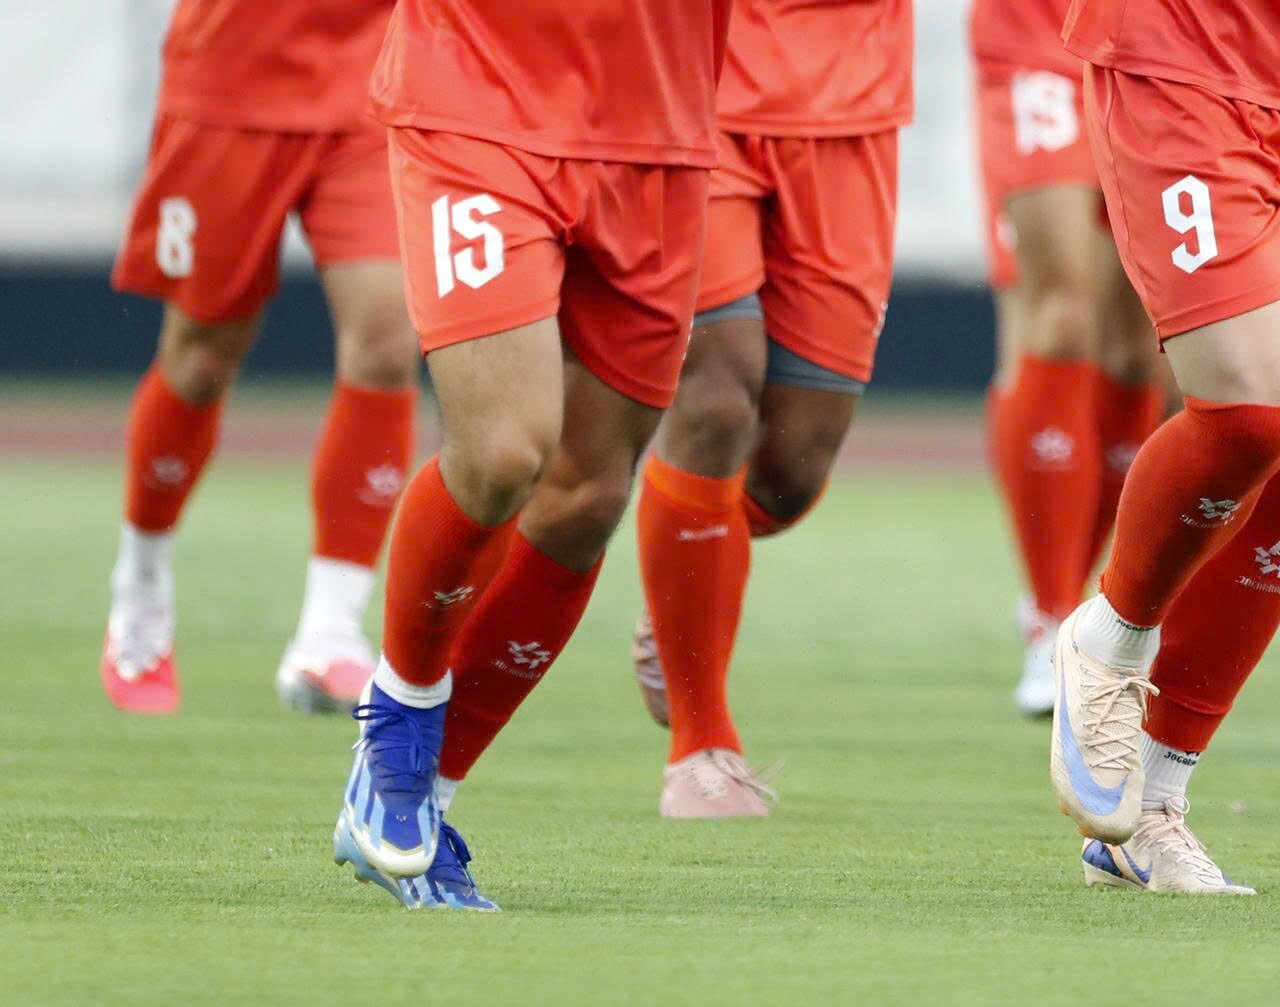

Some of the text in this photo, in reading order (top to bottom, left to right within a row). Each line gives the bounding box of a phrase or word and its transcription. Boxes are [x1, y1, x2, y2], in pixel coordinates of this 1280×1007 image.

[156, 196, 196, 279] 8
[431, 192, 504, 299] 15
[1161, 174, 1218, 274] 9
